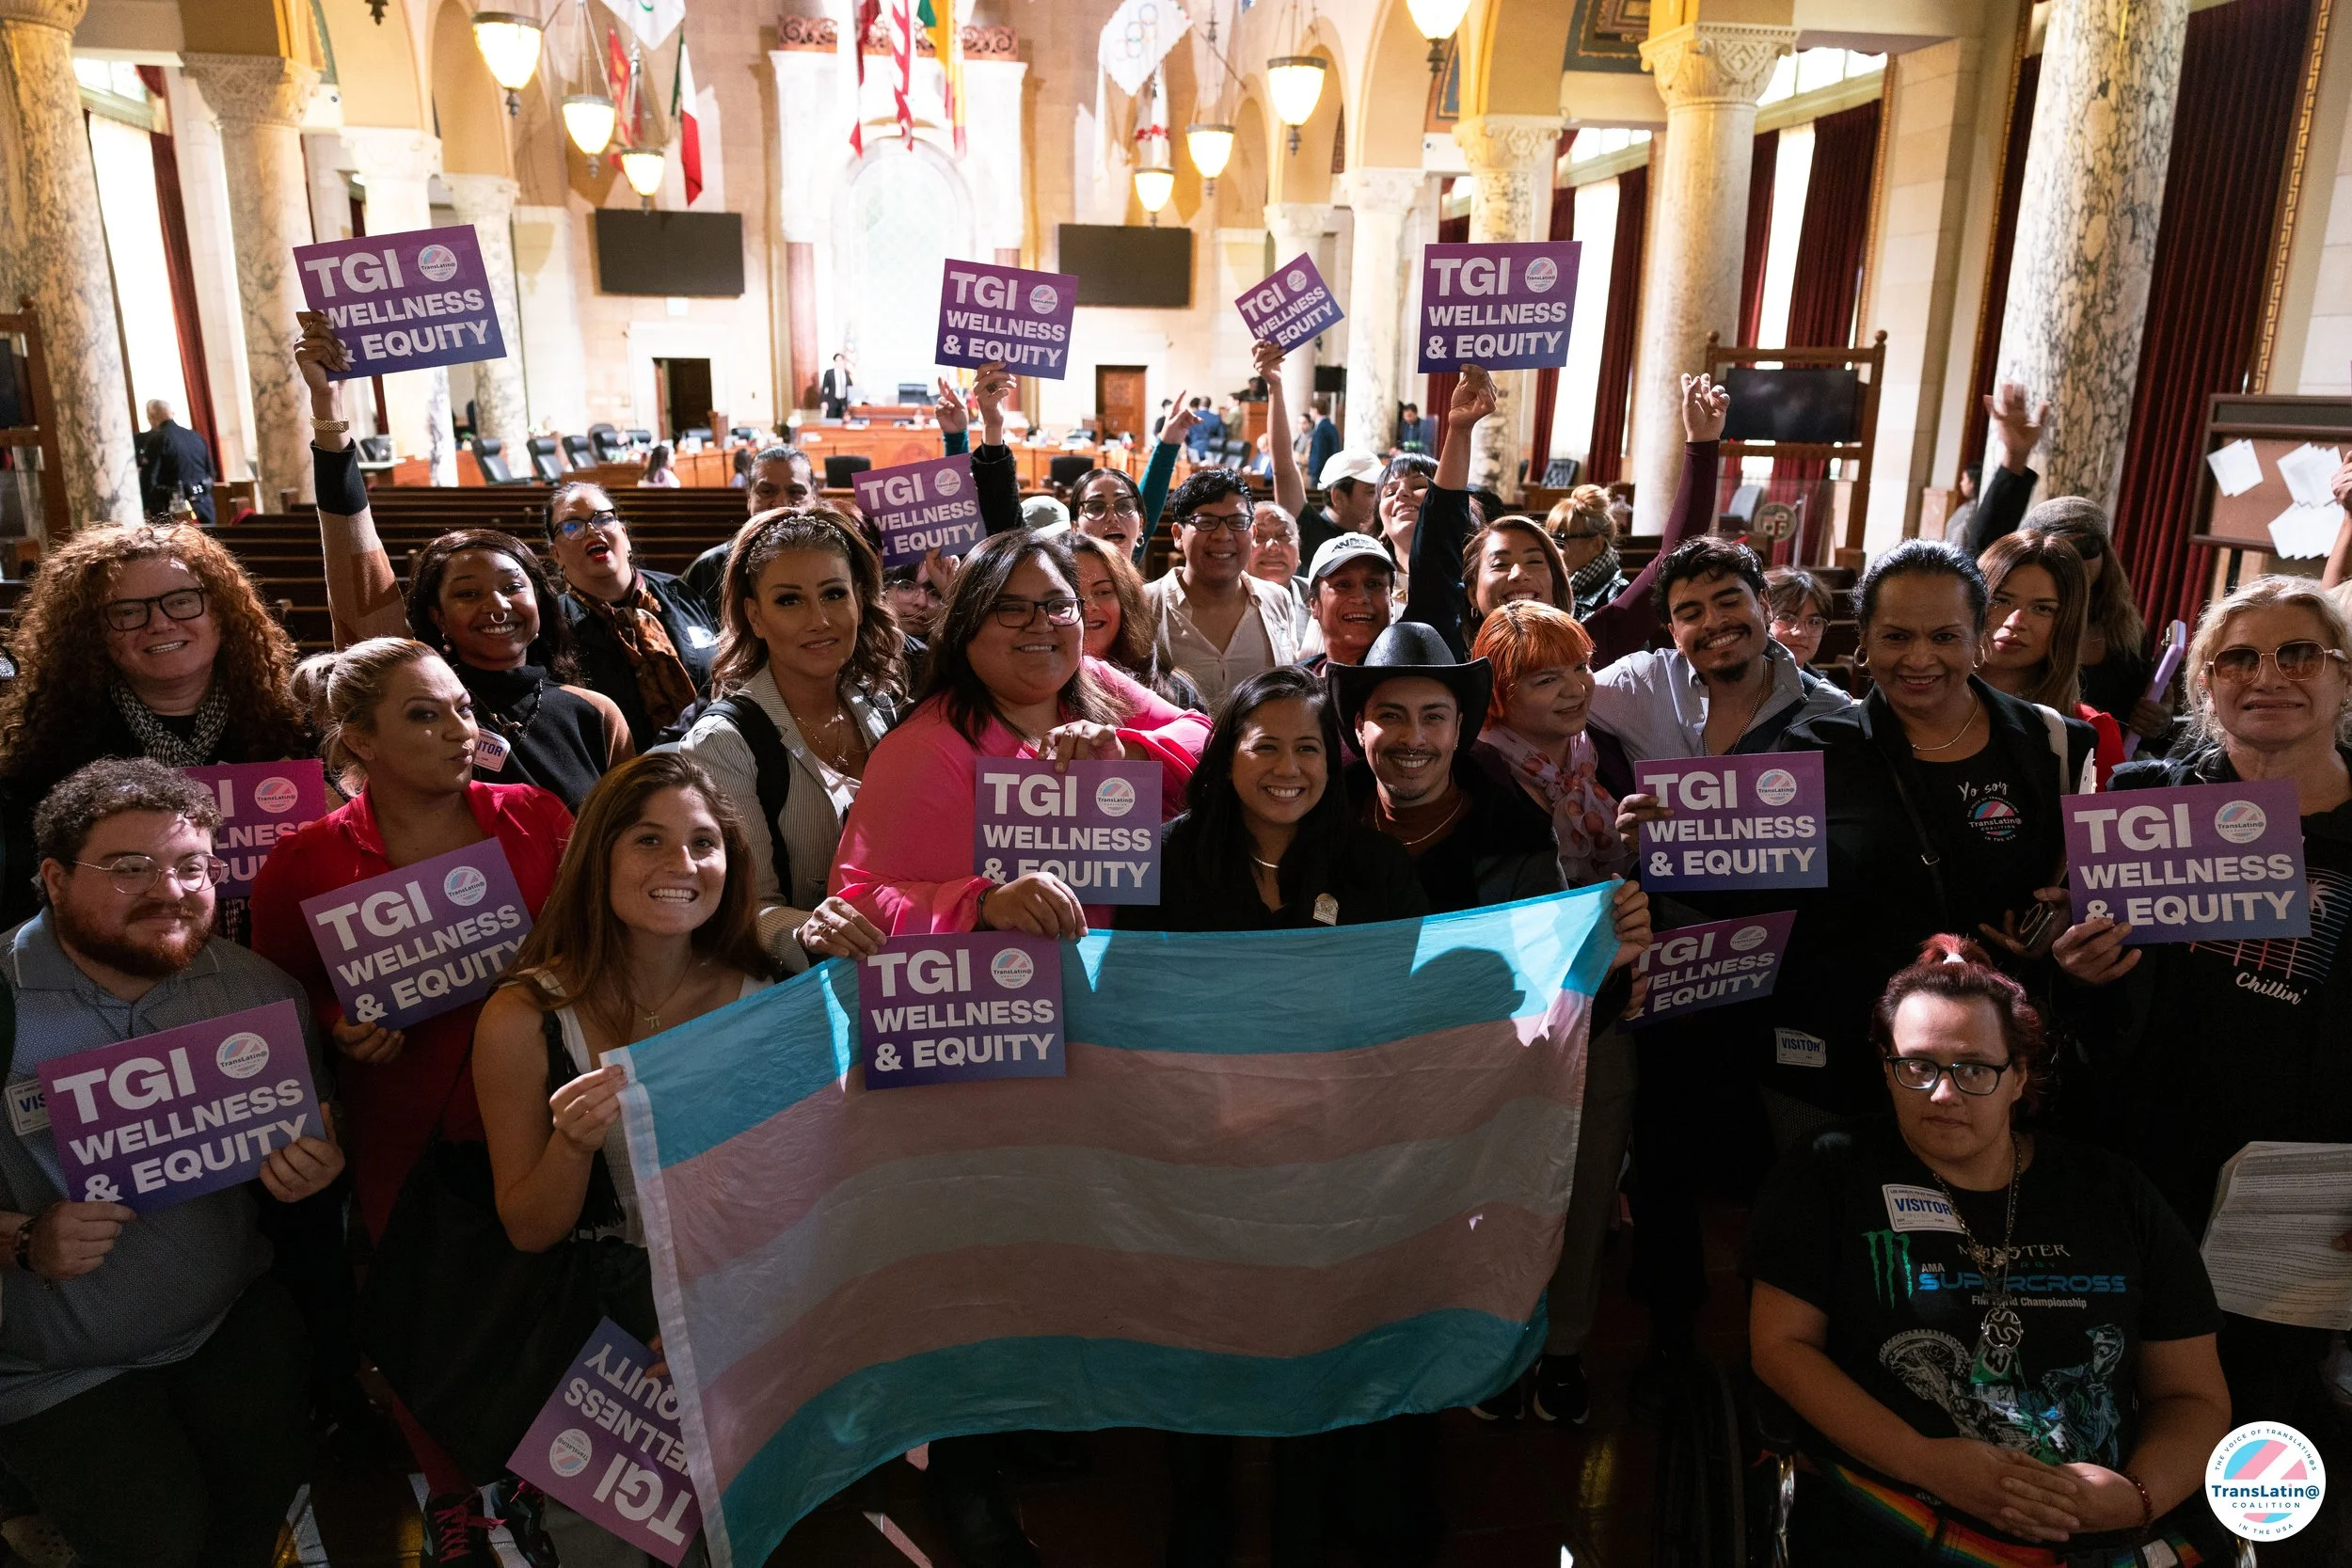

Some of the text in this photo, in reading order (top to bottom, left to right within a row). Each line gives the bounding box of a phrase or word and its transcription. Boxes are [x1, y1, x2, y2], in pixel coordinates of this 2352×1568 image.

[304, 248, 405, 298] TGI
[950, 271, 1018, 310] TGI
[1430, 257, 1511, 296] TGI
[1240, 282, 1287, 322] TGI
[1253, 286, 1327, 339] WELLNESS
[1428, 301, 1567, 326] WELLNESS
[361, 320, 489, 361] EQUITY
[946, 309, 1066, 342] WELLNESS
[1276, 301, 1332, 347] EQUITY
[943, 335, 1063, 367] & EQUITY
[1426, 331, 1564, 359] & EQUITY
[860, 472, 926, 510] TGI
[894, 521, 978, 555] EQUITY
[984, 772, 1077, 816] TGI
[1643, 769, 1738, 811] TGI
[1957, 781, 2010, 801] Yo soy
[982, 824, 1152, 852] WELLNESS
[1646, 815, 1816, 843] WELLNESS
[1968, 817, 2023, 828] TransLatin@
[2074, 803, 2192, 854] TGI
[982, 858, 1007, 885] &
[1648, 847, 1817, 877] & EQUITY
[2079, 854, 2295, 890] WELLNESS
[315, 880, 433, 951] TGI
[2085, 890, 2296, 926] & EQUITY
[337, 904, 521, 988] WELLNESS
[1638, 931, 1717, 973] TGI
[867, 948, 971, 997] TGI
[1653, 971, 1771, 1012] EQUITY
[2235, 971, 2308, 1005] Chillin'
[355, 993, 388, 1023] &
[871, 999, 1055, 1033] WELLNESS
[875, 1033, 1056, 1072] & EQUITY
[53, 1046, 196, 1125] TGI
[69, 1079, 305, 1166] WELLNESS
[84, 1114, 309, 1203] & EQUITY
[1895, 1198, 1953, 1215] VISITOR
[1918, 1272, 2127, 1293] SUPRCROSS
[1921, 1263, 1946, 1274] AMA
[2021, 1296, 2087, 1309] Championship
[593, 1452, 692, 1546] TGI
